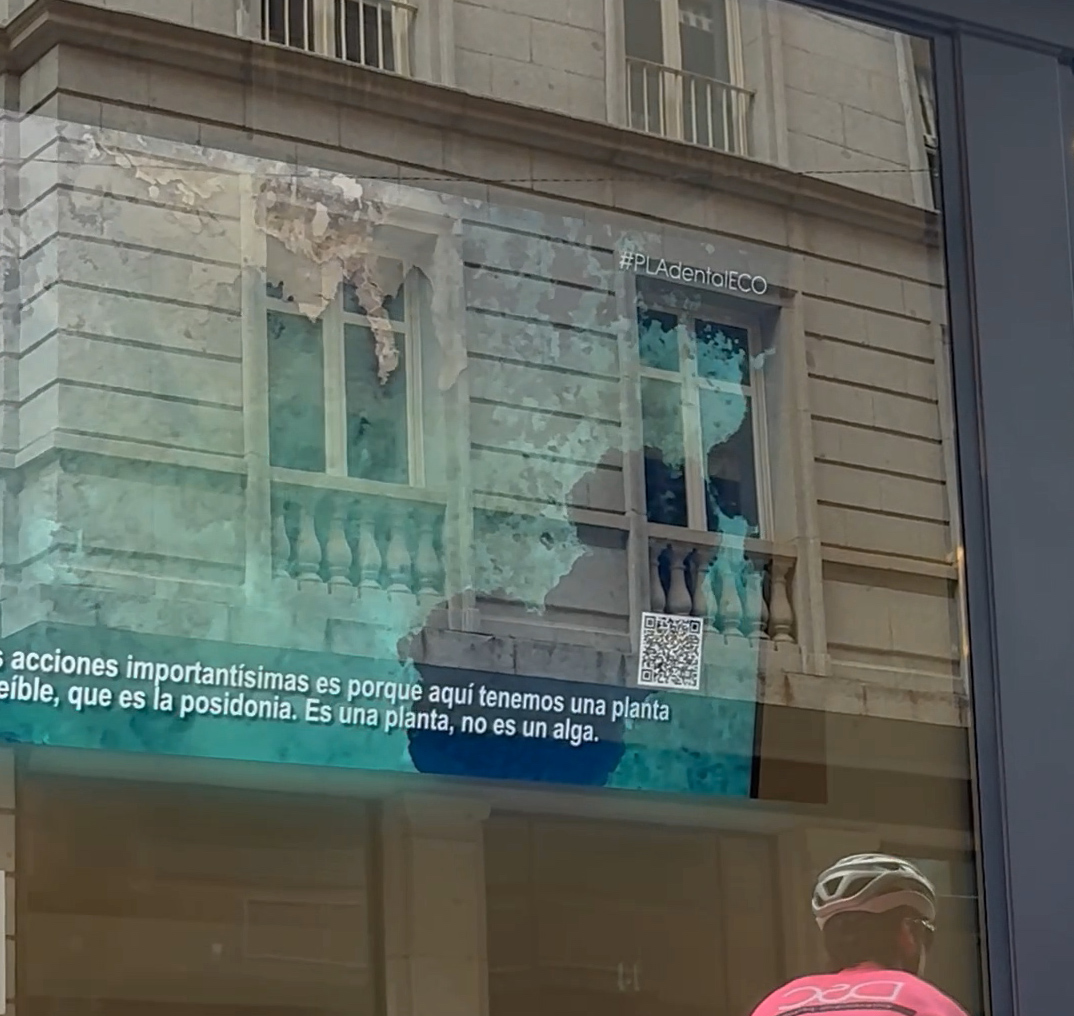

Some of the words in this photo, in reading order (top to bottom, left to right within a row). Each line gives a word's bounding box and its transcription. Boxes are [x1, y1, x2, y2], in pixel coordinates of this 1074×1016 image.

[619, 251, 768, 295] #PLAdentalECO
[11, 648, 119, 678] acciones
[126, 654, 309, 693] importantísimas
[316, 676, 341, 695] es
[347, 677, 422, 702] porque
[429, 682, 474, 707] aquí
[479, 686, 564, 713] tenemos
[571, 695, 606, 716] una
[611, 696, 670, 722] planta
[67, 684, 112, 711] que
[118, 689, 146, 709] es
[153, 686, 173, 712] la
[179, 690, 297, 720] posidonia.
[304, 698, 332, 723] Es
[338, 704, 378, 727] una
[384, 706, 455, 736] planta,
[461, 715, 488, 735] no
[493, 718, 517, 737] es
[522, 719, 548, 740] un
[553, 719, 600, 747] alga.
